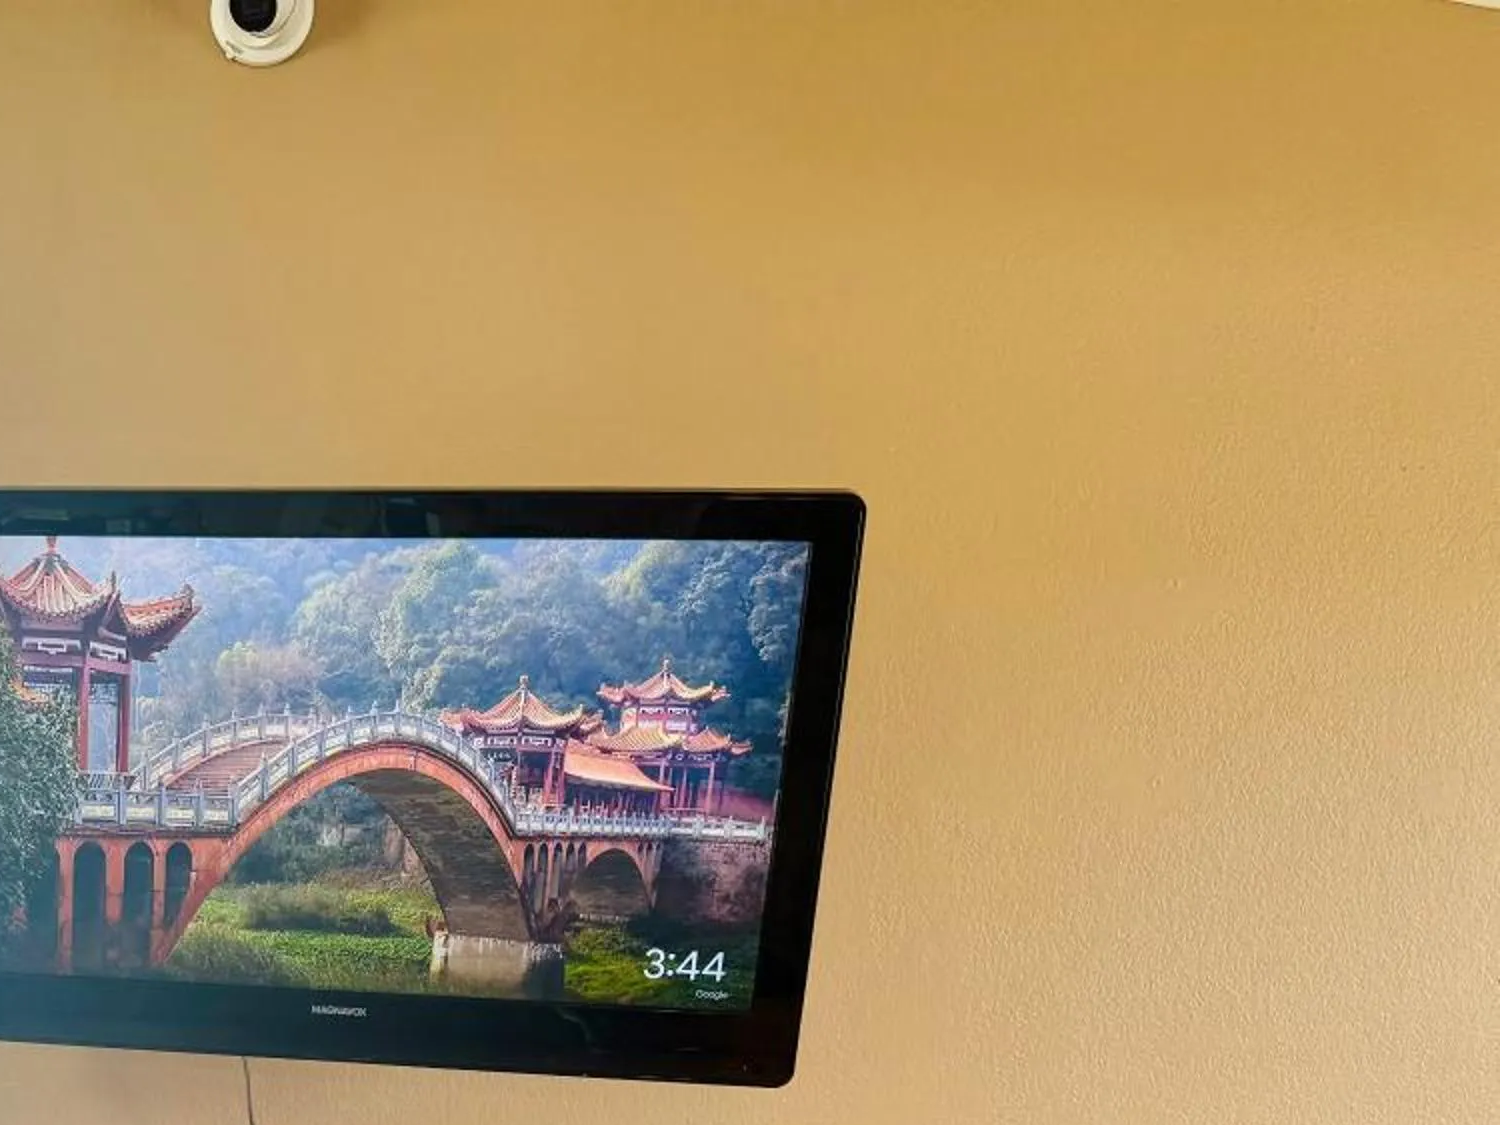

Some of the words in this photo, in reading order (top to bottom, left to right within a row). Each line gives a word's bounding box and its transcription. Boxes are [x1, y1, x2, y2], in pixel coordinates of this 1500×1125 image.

[643, 947, 727, 981] 3:44
[695, 989, 729, 1001] Google
[311, 1005, 368, 1017] MAGNAVOX
